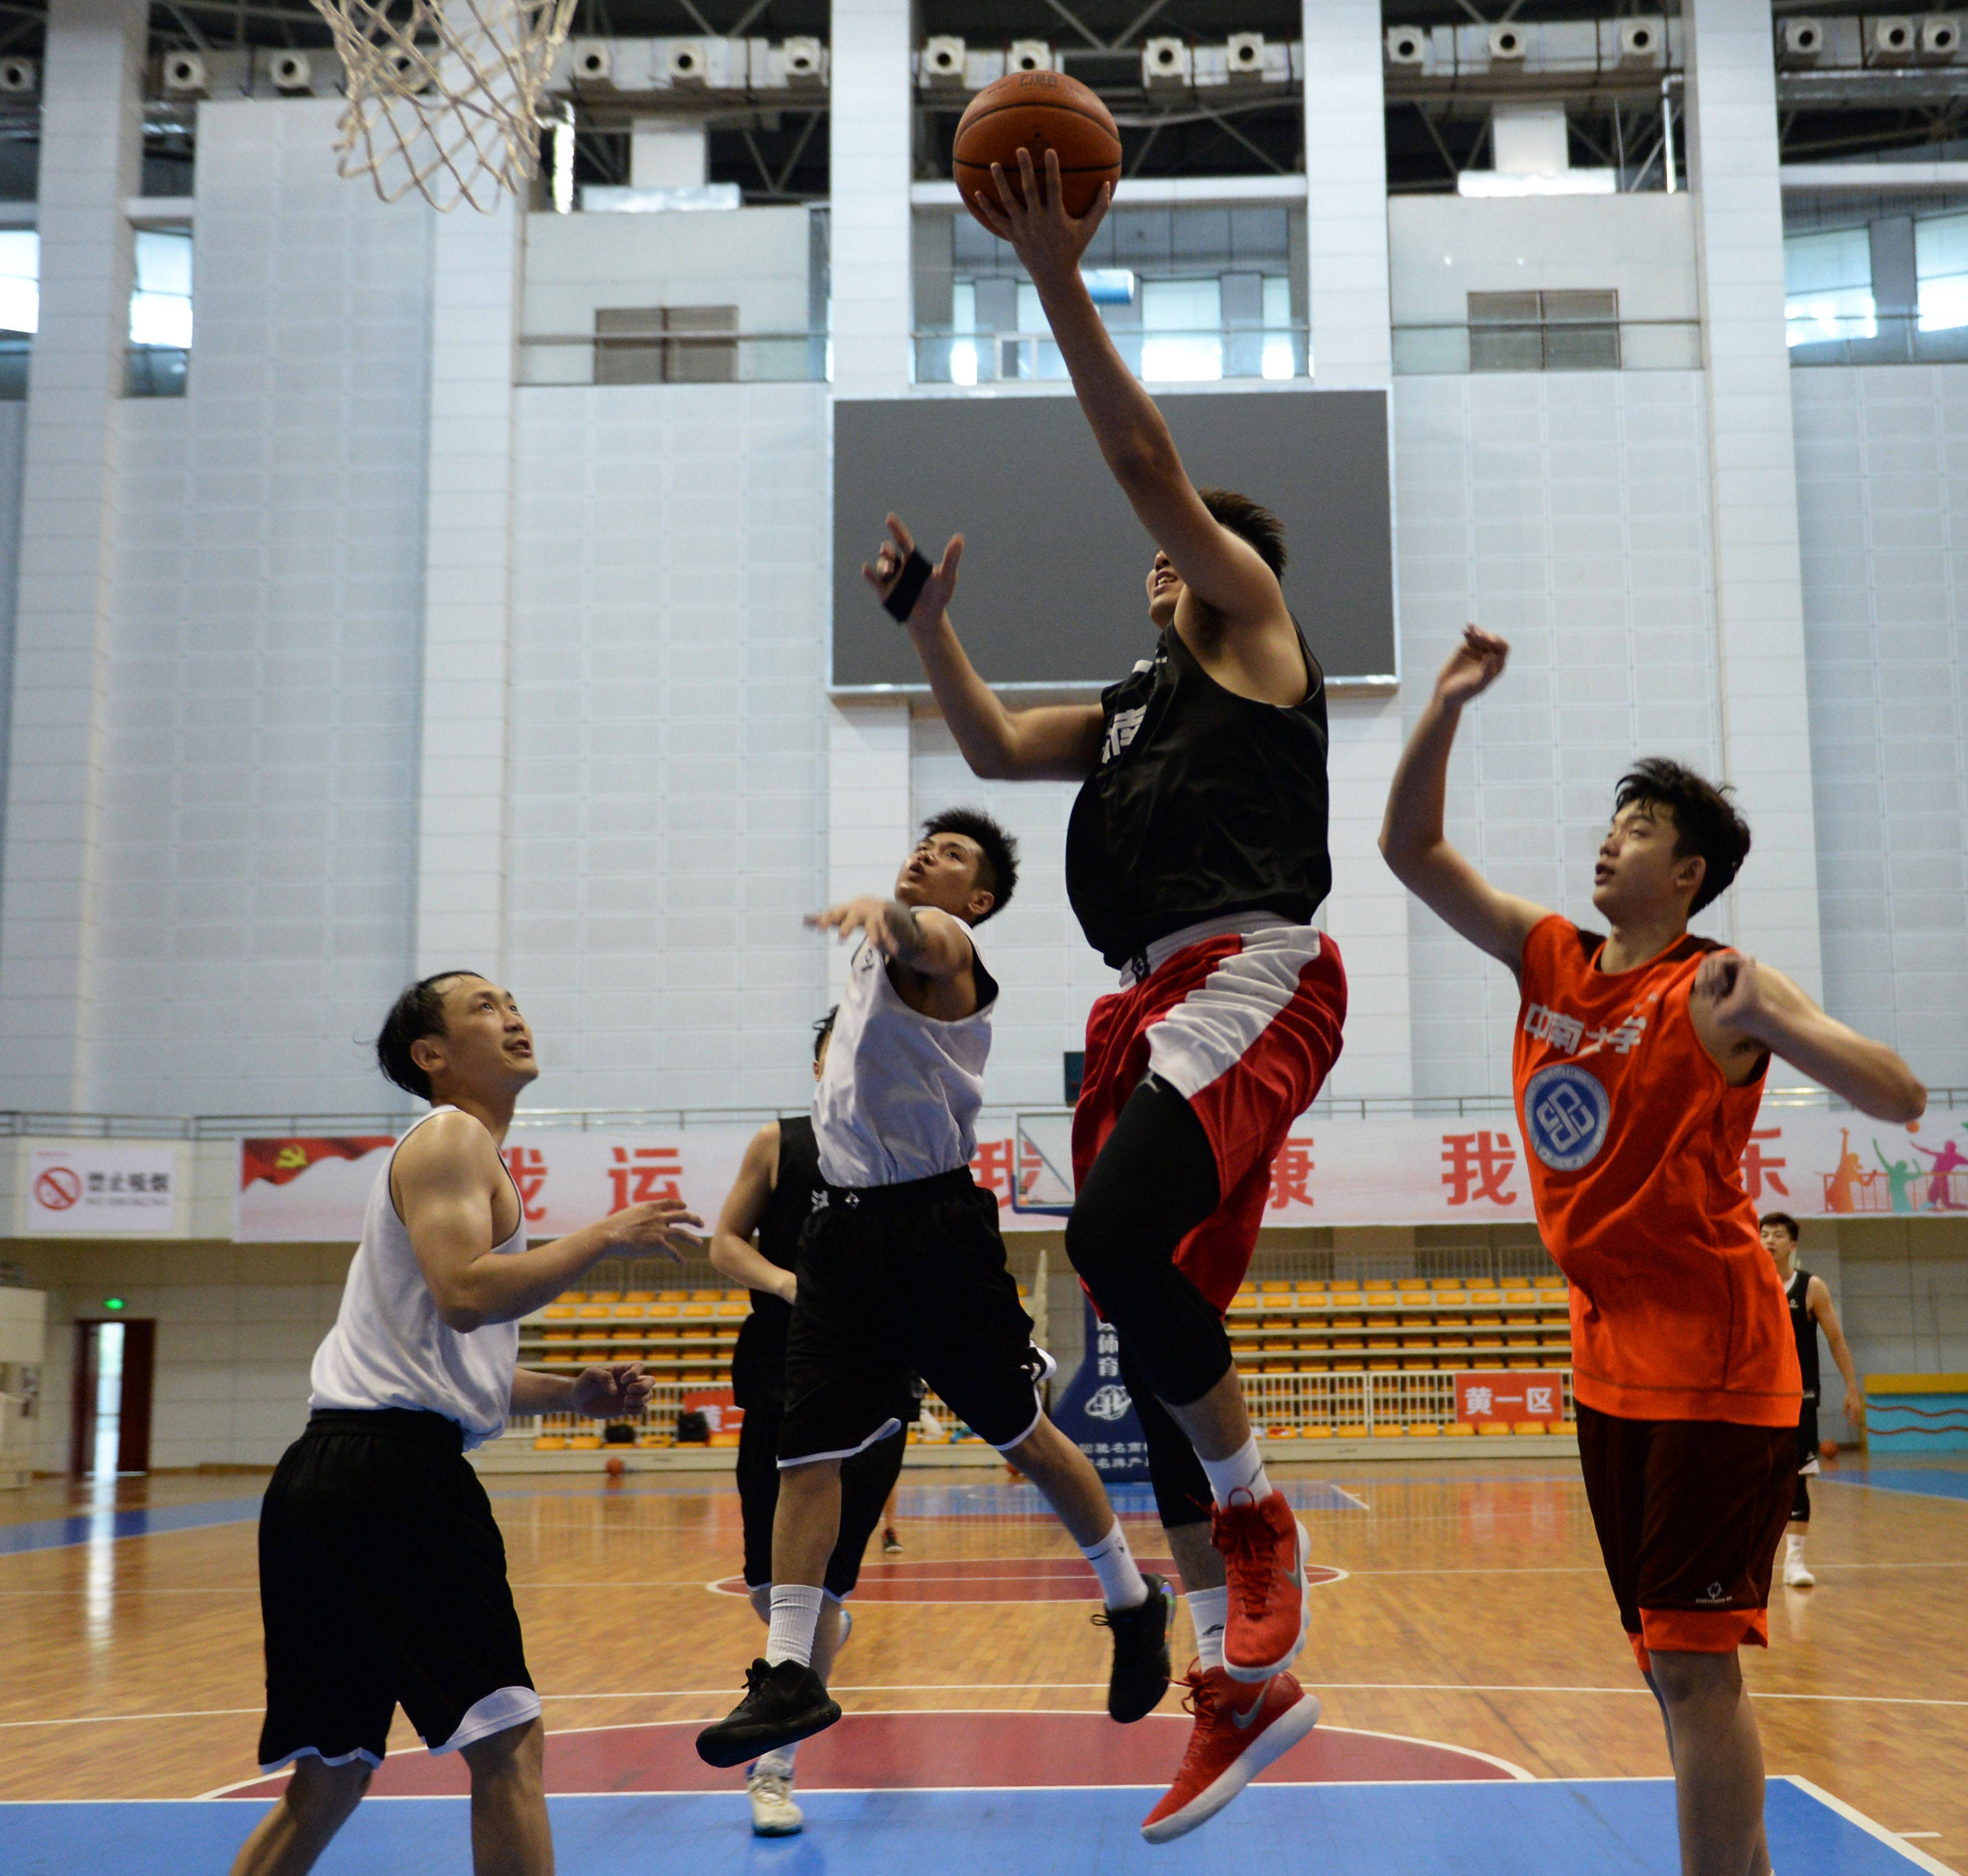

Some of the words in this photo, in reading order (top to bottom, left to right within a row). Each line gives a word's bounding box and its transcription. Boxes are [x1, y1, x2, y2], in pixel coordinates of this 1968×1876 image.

[1442, 1131, 1518, 1206] 我
[1465, 1386, 1553, 1416] 黄一区
